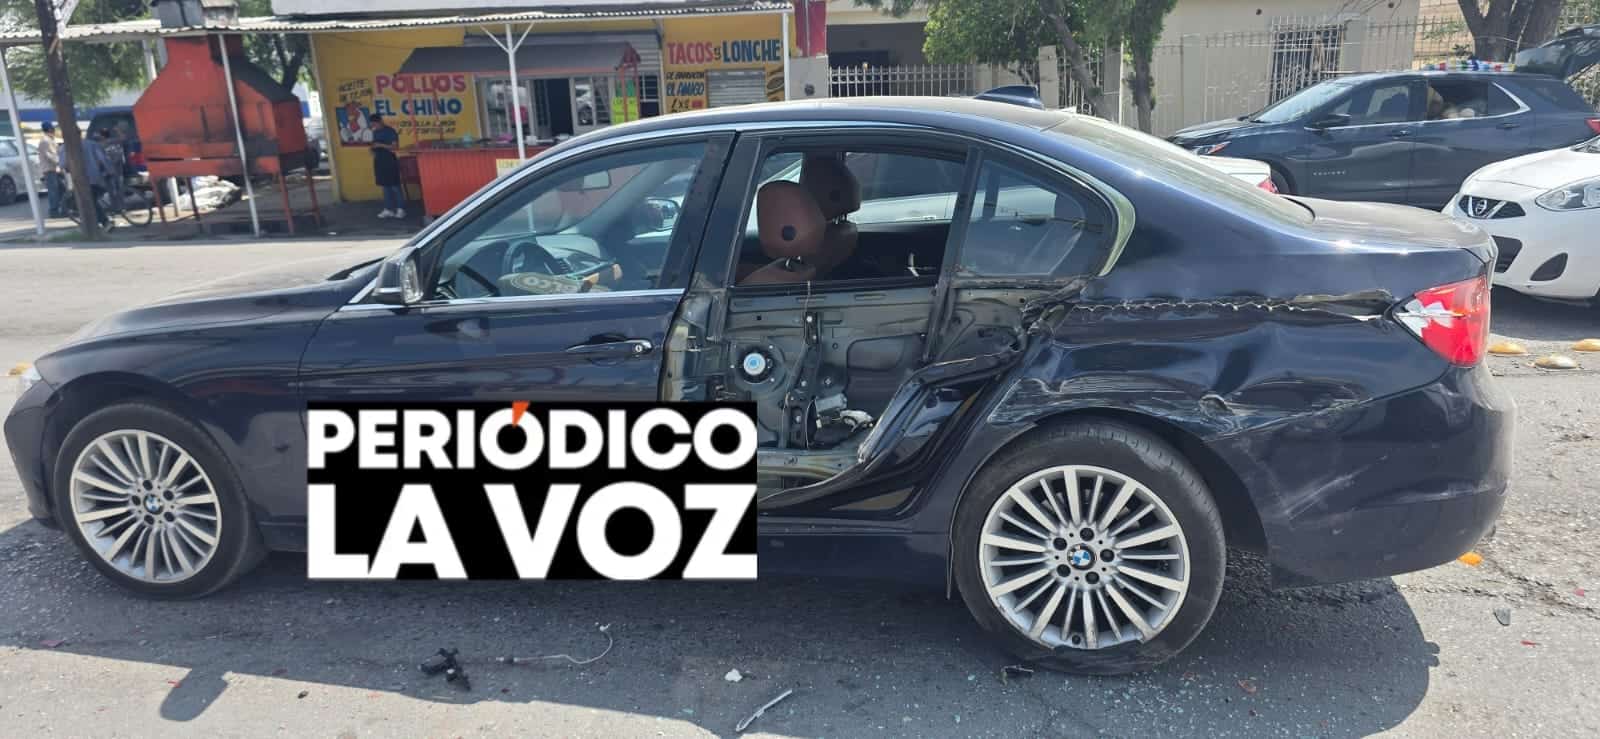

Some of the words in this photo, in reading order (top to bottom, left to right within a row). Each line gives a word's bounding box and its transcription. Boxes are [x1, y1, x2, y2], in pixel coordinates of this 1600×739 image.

[668, 43, 714, 64] TACOS
[723, 41, 783, 63] LONCHE
[376, 75, 466, 94] POLLOS
[375, 100, 396, 116] EL
[402, 98, 461, 115] CHINO
